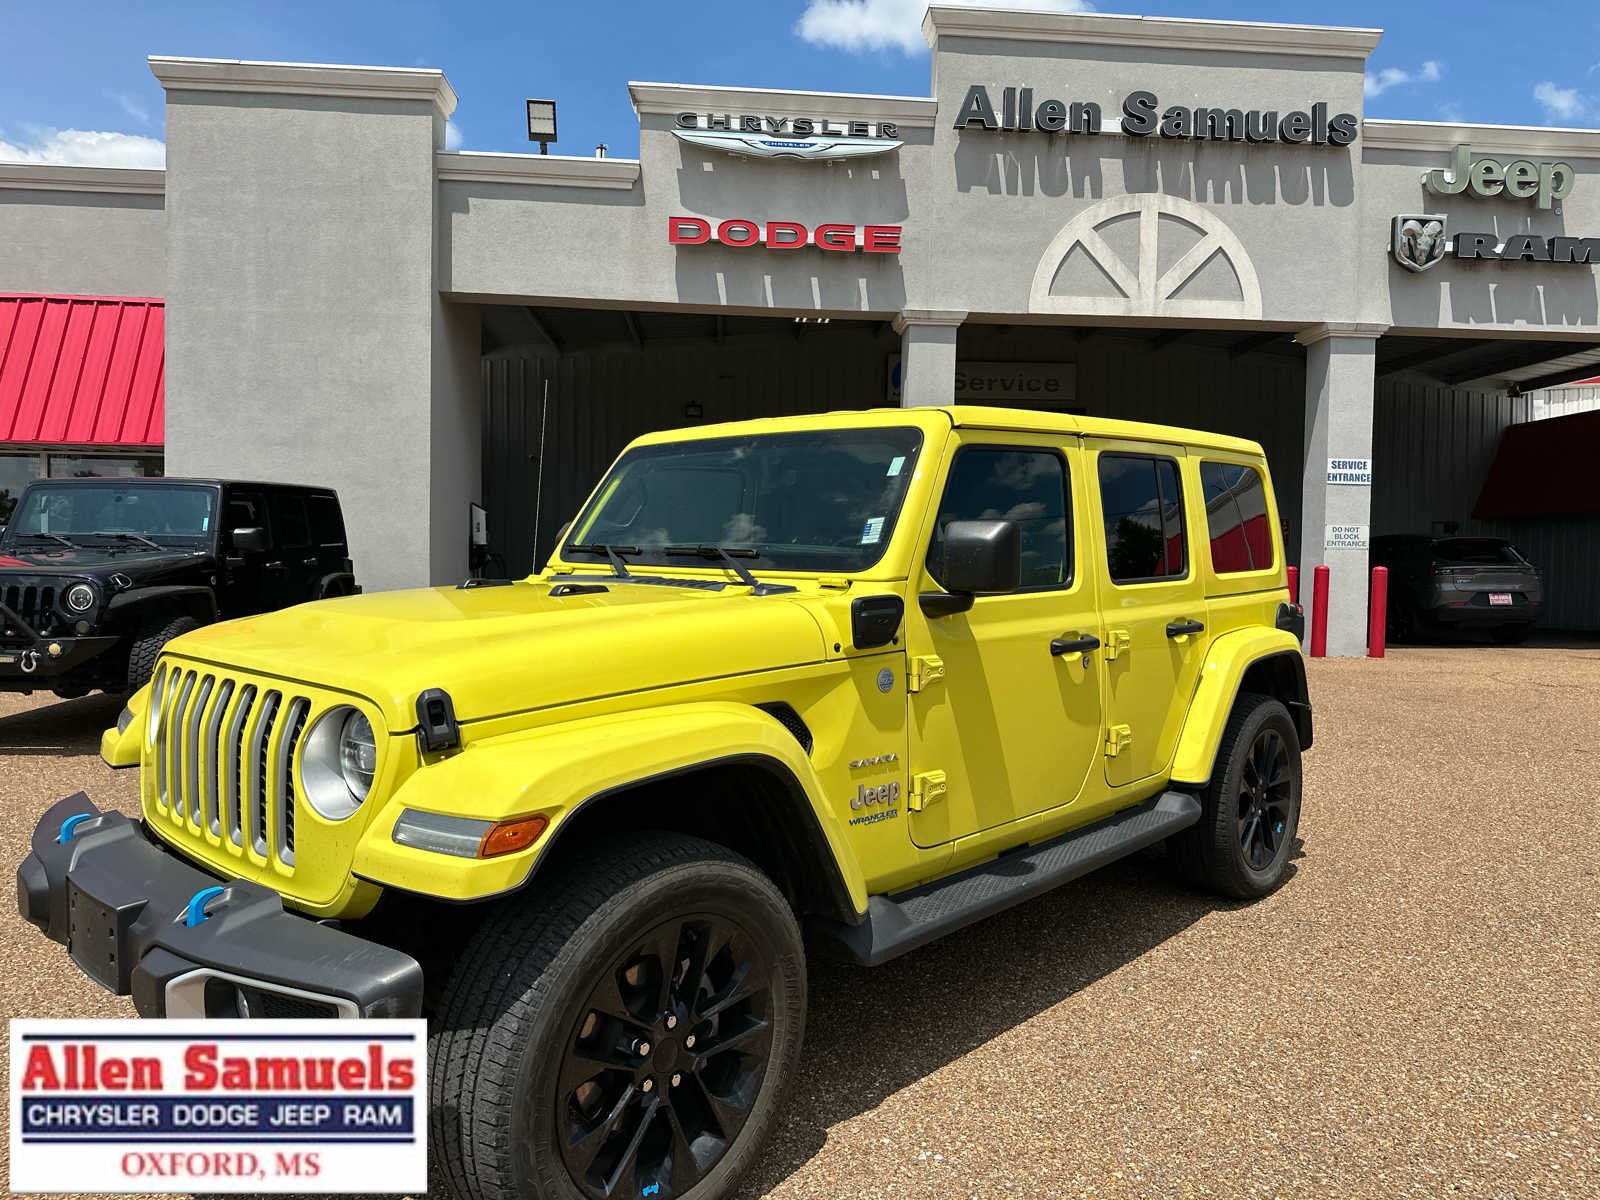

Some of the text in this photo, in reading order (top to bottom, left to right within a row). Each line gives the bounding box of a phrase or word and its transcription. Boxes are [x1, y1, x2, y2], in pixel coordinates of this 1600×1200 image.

[677, 112, 899, 138] CHRYSLER
[953, 85, 1358, 148] Allen Samuels
[1421, 144, 1575, 209] Jeep
[669, 216, 902, 253] DODGE
[1453, 233, 1600, 263] RAM
[955, 371, 1061, 392] Service
[1327, 473, 1371, 482] ENTRANCE
[1331, 460, 1367, 470] SERVICE
[849, 753, 898, 768] SAHARA
[850, 781, 900, 811] Jeep
[849, 809, 898, 826] WRANGLER
